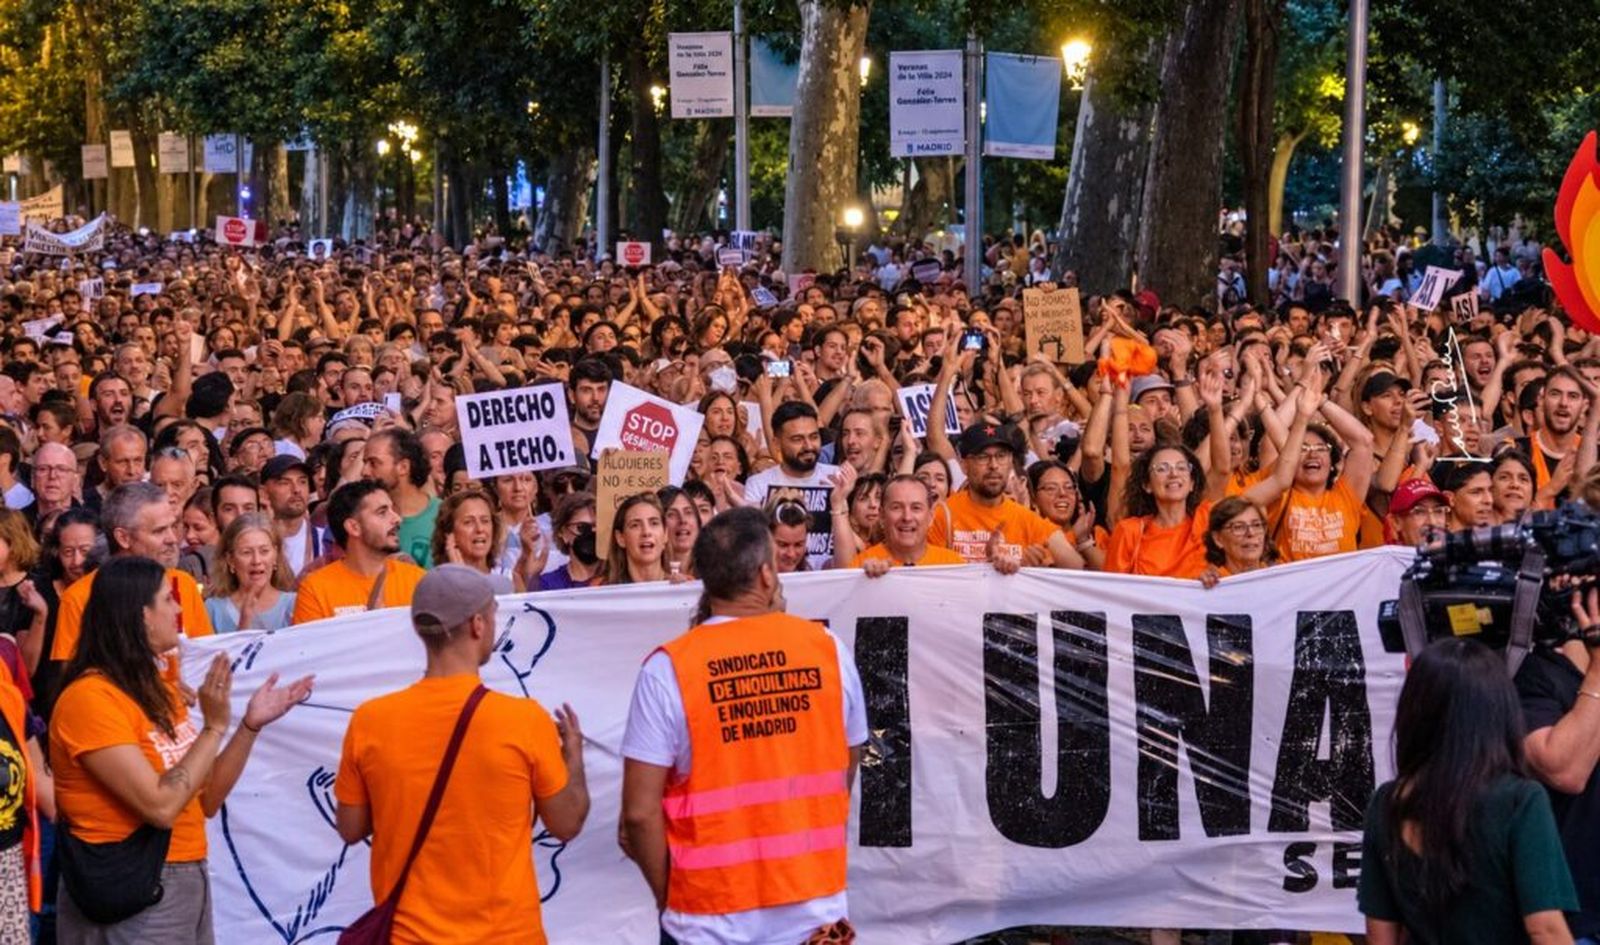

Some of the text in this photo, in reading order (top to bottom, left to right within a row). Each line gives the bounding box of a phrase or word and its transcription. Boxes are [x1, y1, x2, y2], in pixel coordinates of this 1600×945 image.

[917, 72, 933, 80] Villa
[934, 71, 953, 79] 2024
[916, 143, 953, 152] MADRID
[466, 391, 556, 428] DERECHO
[627, 413, 676, 441] STOP
[479, 435, 565, 471] A TECHO.
[602, 475, 620, 488] NO
[707, 650, 787, 677] SINDICATO
[712, 669, 819, 701] DE INQUILINAS
[718, 694, 811, 722] E INQUILINOS
[721, 716, 797, 744] DE MADRID
[983, 610, 1376, 849] UNA
